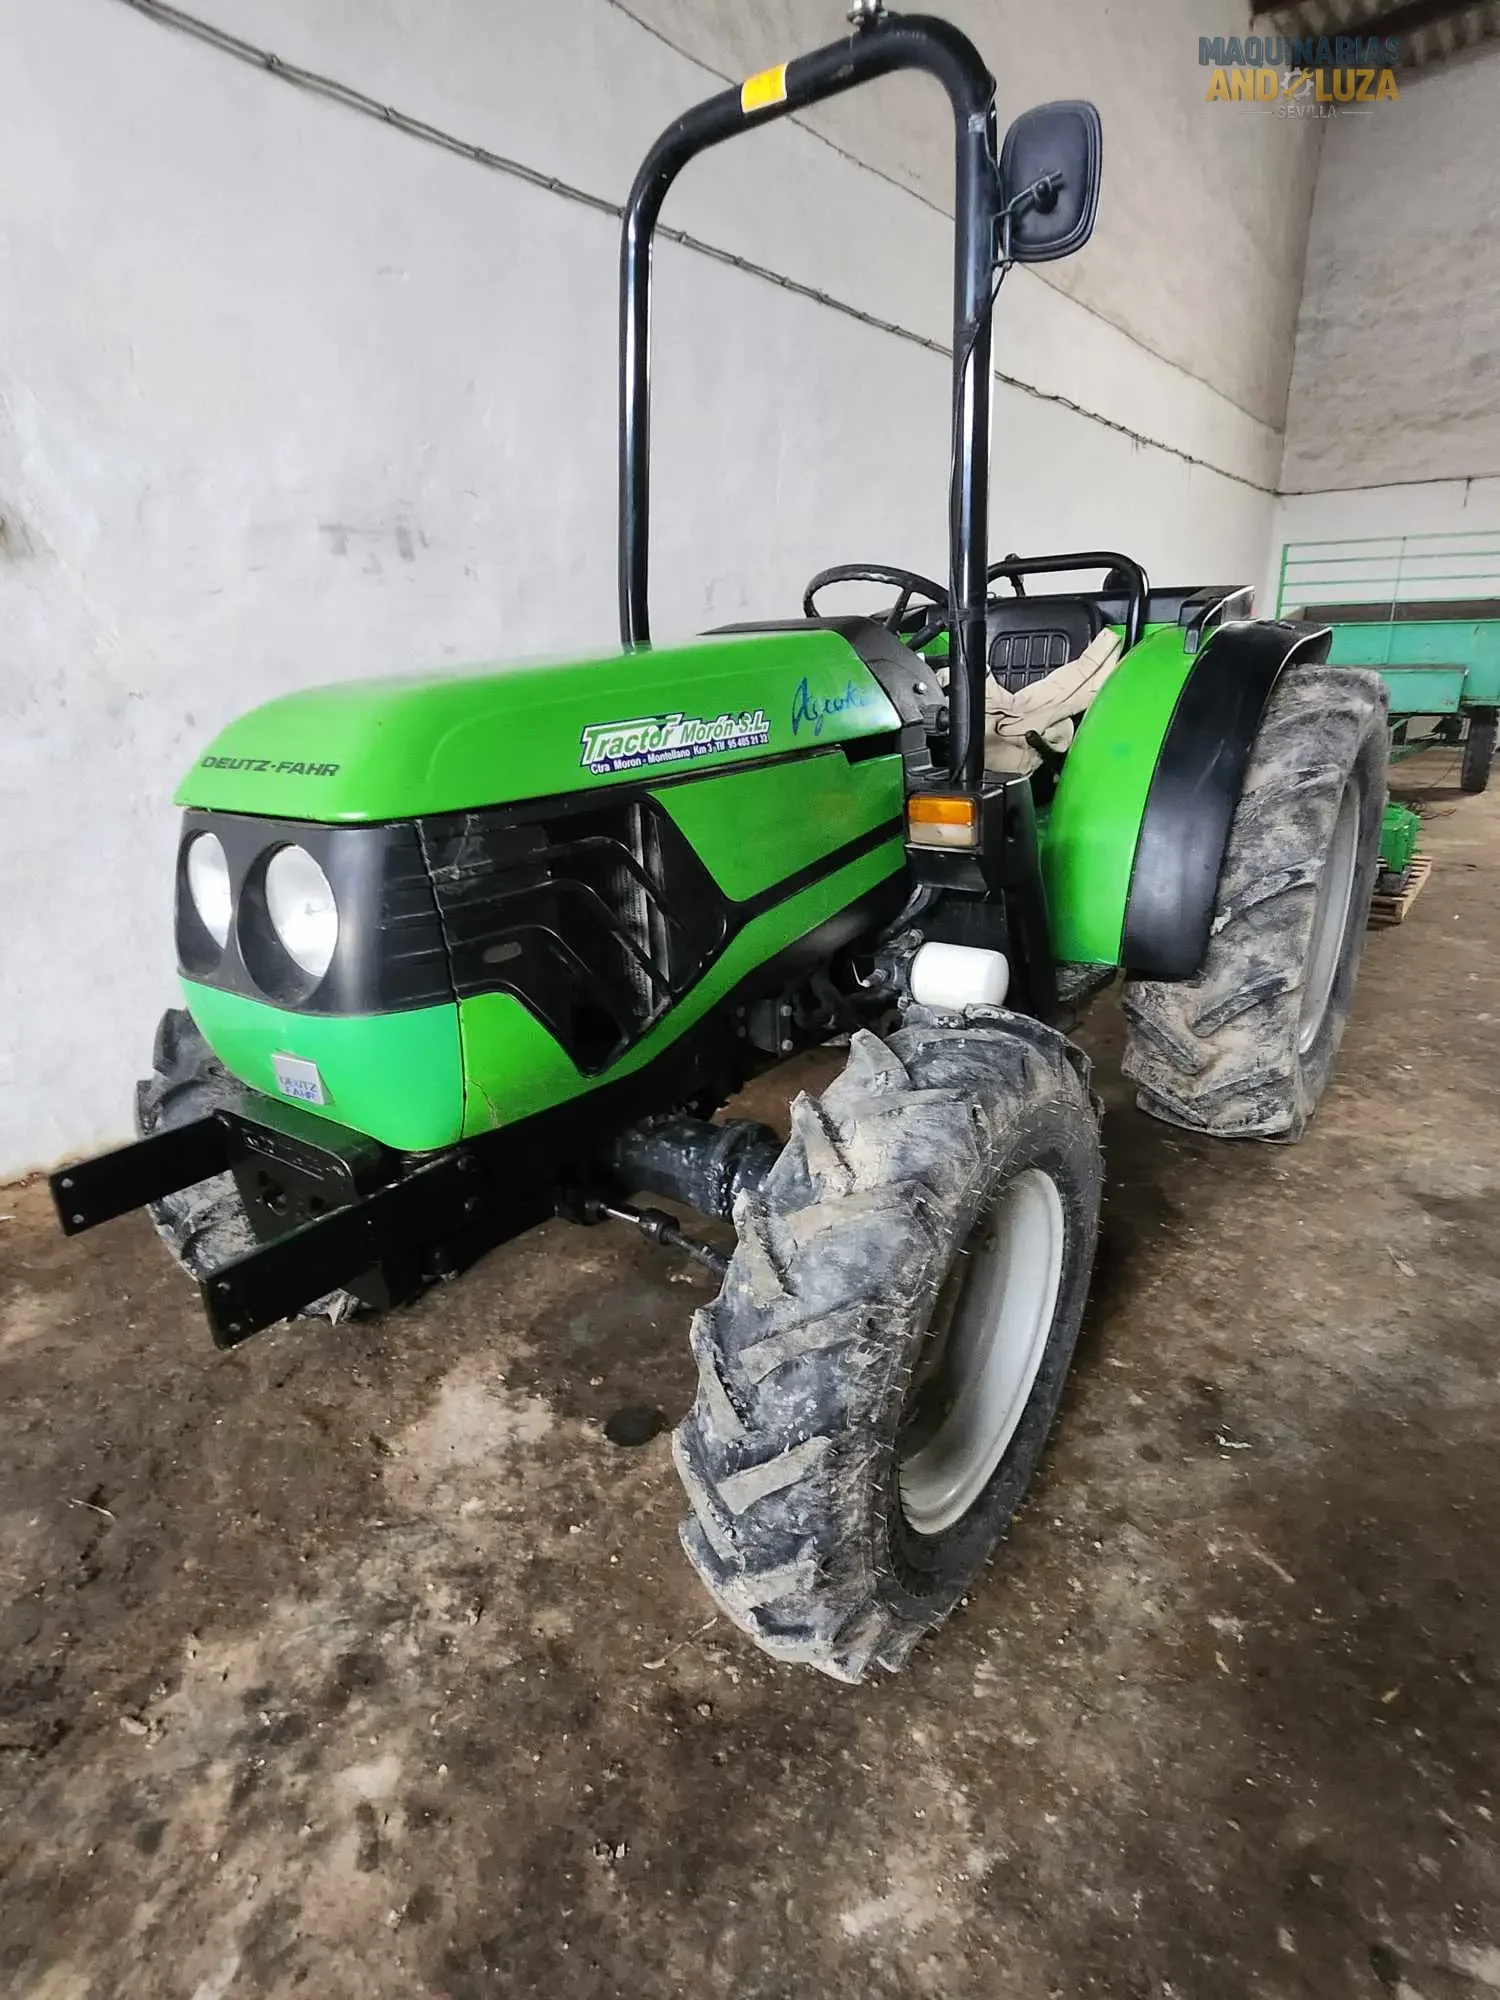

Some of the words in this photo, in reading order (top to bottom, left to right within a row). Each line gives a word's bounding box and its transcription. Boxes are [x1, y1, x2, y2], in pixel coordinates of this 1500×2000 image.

[582, 713, 684, 766] Tractor
[680, 715, 734, 745] Morón
[739, 710, 770, 732] S.L.
